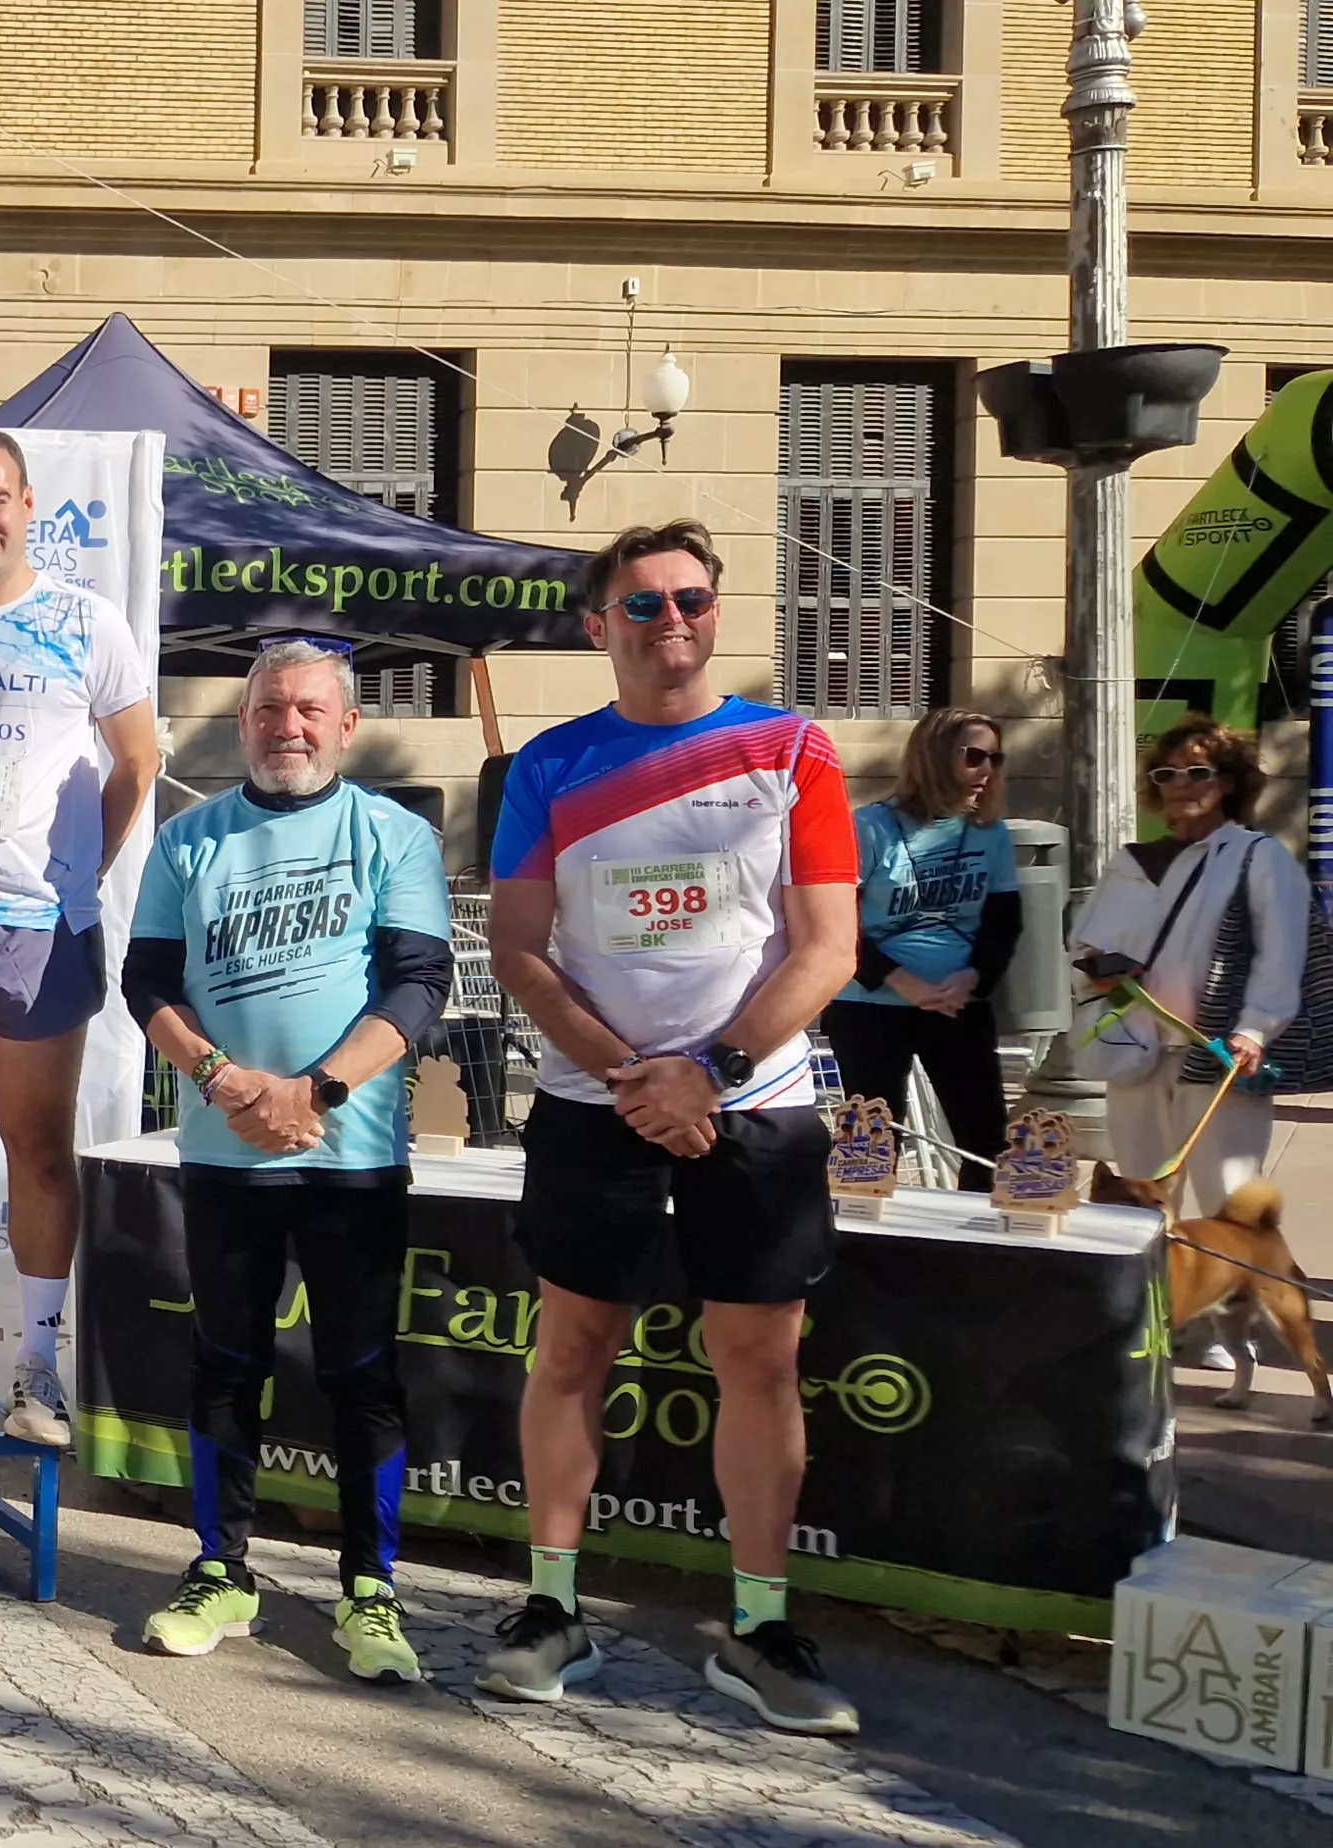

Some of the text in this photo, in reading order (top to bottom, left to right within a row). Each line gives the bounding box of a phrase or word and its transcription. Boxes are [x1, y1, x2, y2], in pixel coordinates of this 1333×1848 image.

[1184, 529, 1252, 546] SPORT
[160, 546, 567, 613] tlecksport.com
[644, 863, 705, 875] CARRERA
[227, 878, 324, 911] III CARRERA
[629, 885, 707, 916] 398
[205, 893, 352, 964] EMPRESAS
[641, 933, 667, 947] 8K
[646, 918, 693, 931] JOSE
[226, 945, 312, 975] ESIC HUESCA
[836, 1164, 891, 1178] EMPRESAS
[1144, 1602, 1238, 1691] LA
[1124, 1651, 1244, 1744] 125
[1250, 1652, 1282, 1756] AMBAR
